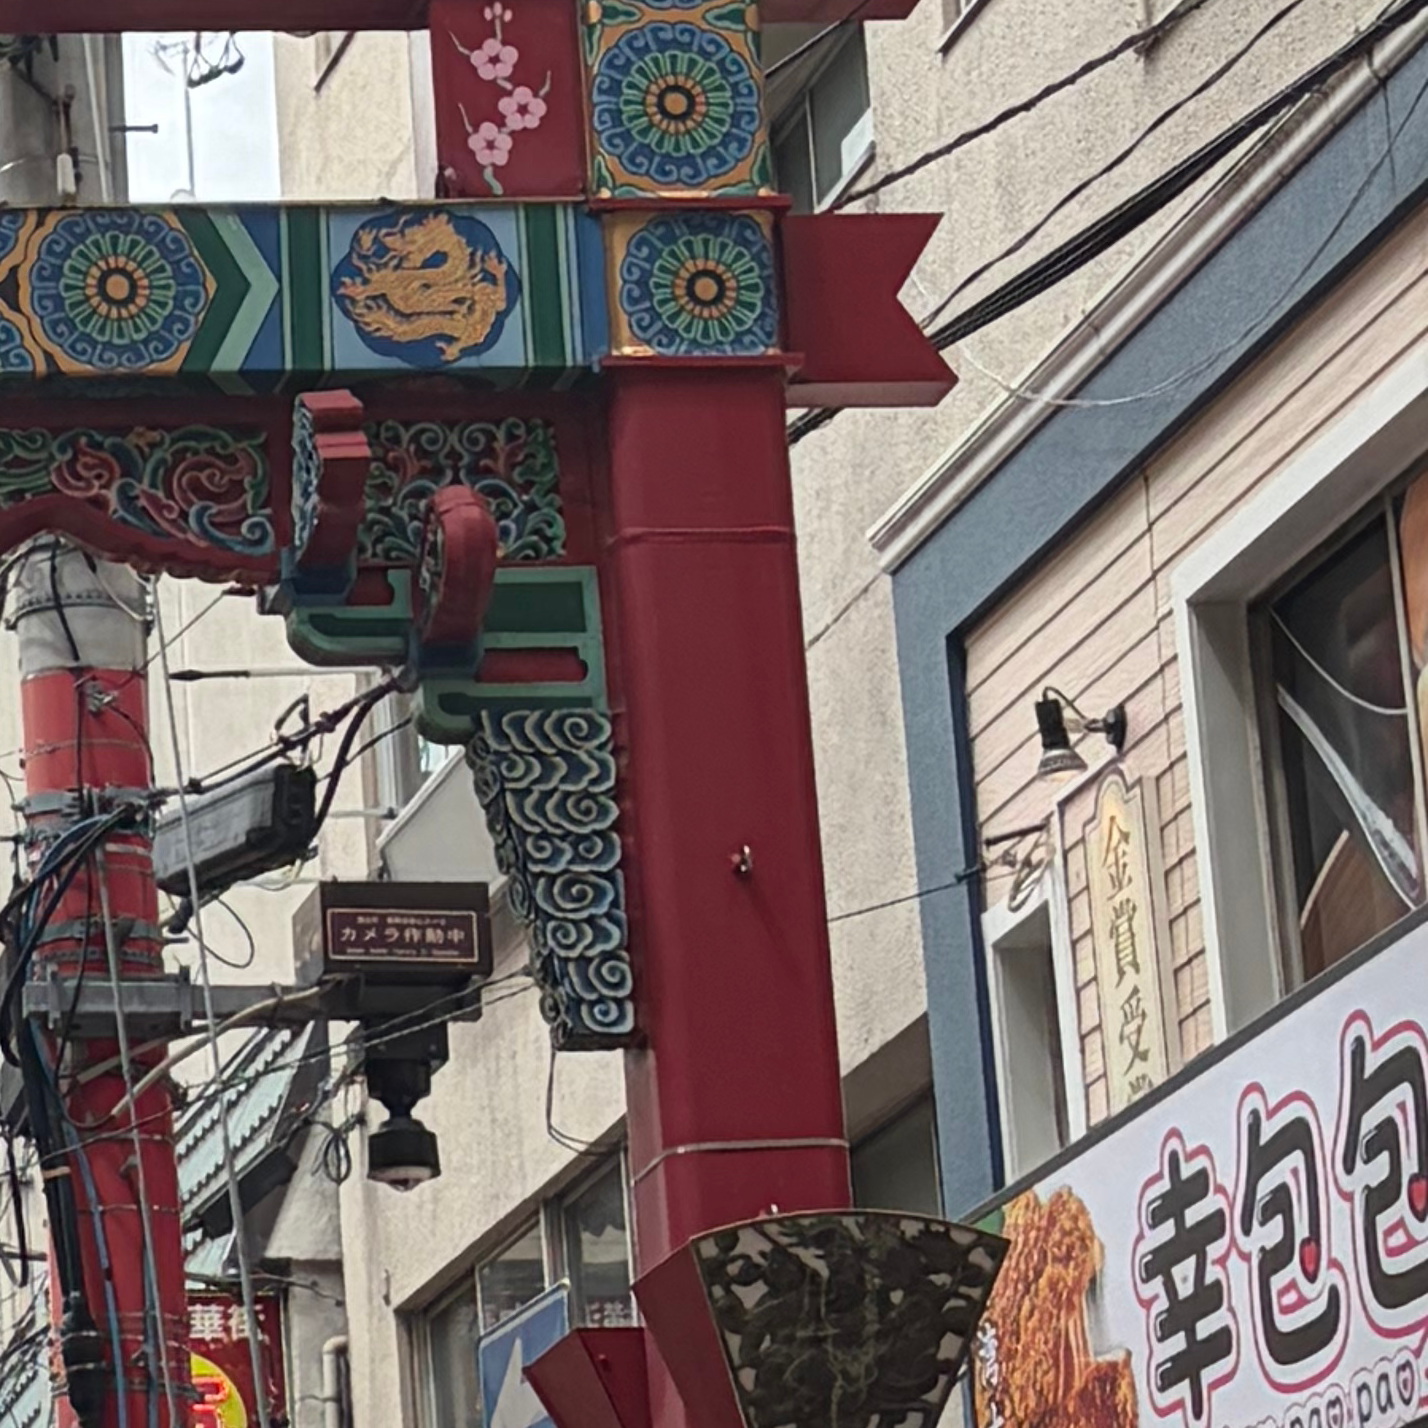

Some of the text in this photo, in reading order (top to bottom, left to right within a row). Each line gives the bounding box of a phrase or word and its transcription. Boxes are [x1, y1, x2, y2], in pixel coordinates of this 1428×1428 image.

[340, 926, 466, 944] カメラ作動中
[1141, 1034, 1428, 1420] 幸包包
